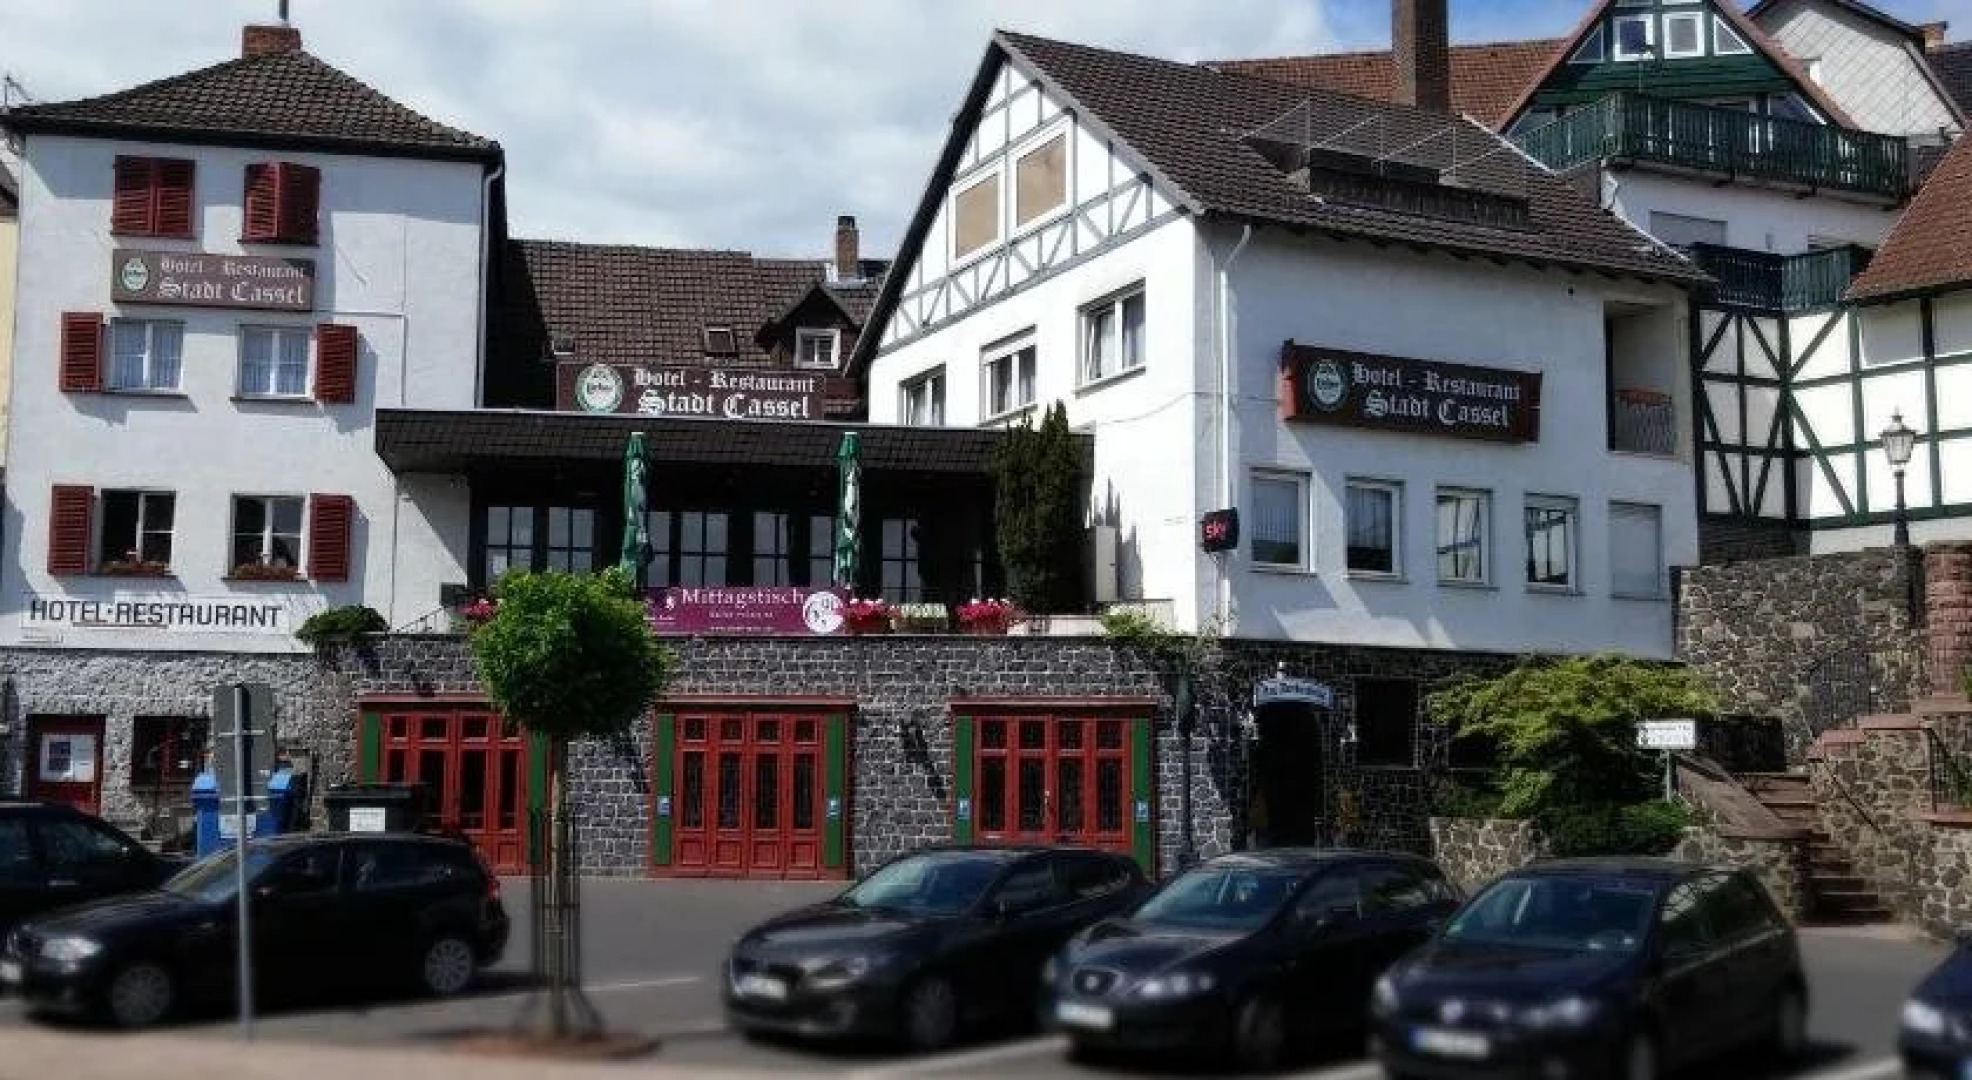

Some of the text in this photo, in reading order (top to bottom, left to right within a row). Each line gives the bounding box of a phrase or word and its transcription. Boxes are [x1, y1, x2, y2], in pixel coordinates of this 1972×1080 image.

[161, 255, 203, 275] Hotel
[157, 276, 304, 304] Stadt Cassel
[634, 368, 686, 387] Hotel
[709, 371, 815, 393] Restaurant
[1352, 361, 1400, 386] Hotel
[1425, 370, 1521, 400] Restaurant
[638, 389, 810, 419] Stadt Cassel
[1364, 389, 1509, 427] Stadt Cassel
[682, 588, 804, 609] Mittagstisch
